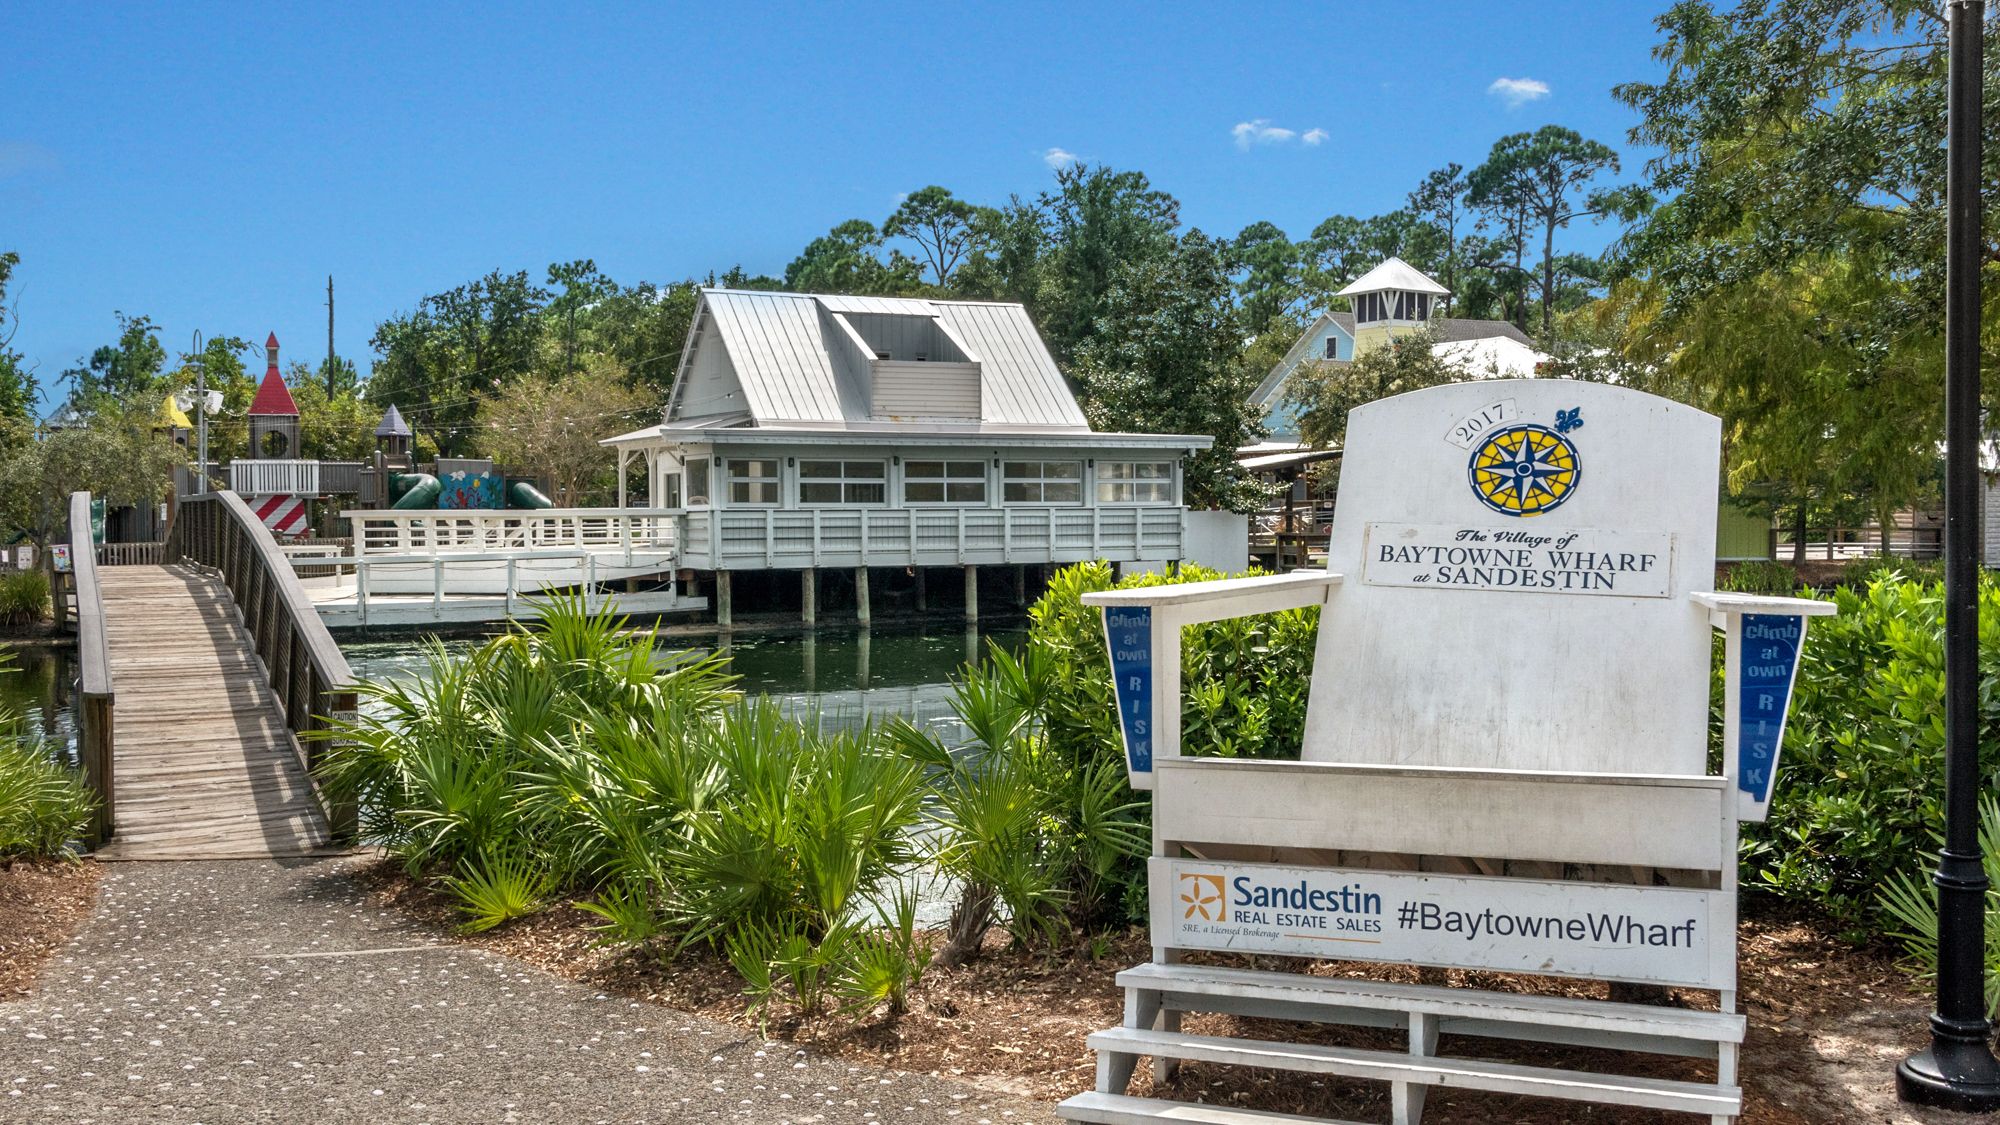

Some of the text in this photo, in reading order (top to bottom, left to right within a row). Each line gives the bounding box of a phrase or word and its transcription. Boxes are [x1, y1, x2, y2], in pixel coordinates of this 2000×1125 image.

[1455, 404, 1503, 442] 2017
[1455, 529, 1579, 550] The Village of
[1379, 544, 1657, 572] BAYTOWNE WHARF
[1413, 565, 1616, 590] at SANDESTIN
[1117, 649, 1147, 662] own
[1748, 664, 1786, 678] own
[1233, 876, 1381, 915] Sandestin
[1211, 926, 1240, 936] Licensed
[1243, 927, 1280, 941] Brokerage
[1234, 910, 1381, 933] REAL ESTATE SALES
[1397, 901, 1696, 948] #BaytowneWharf
